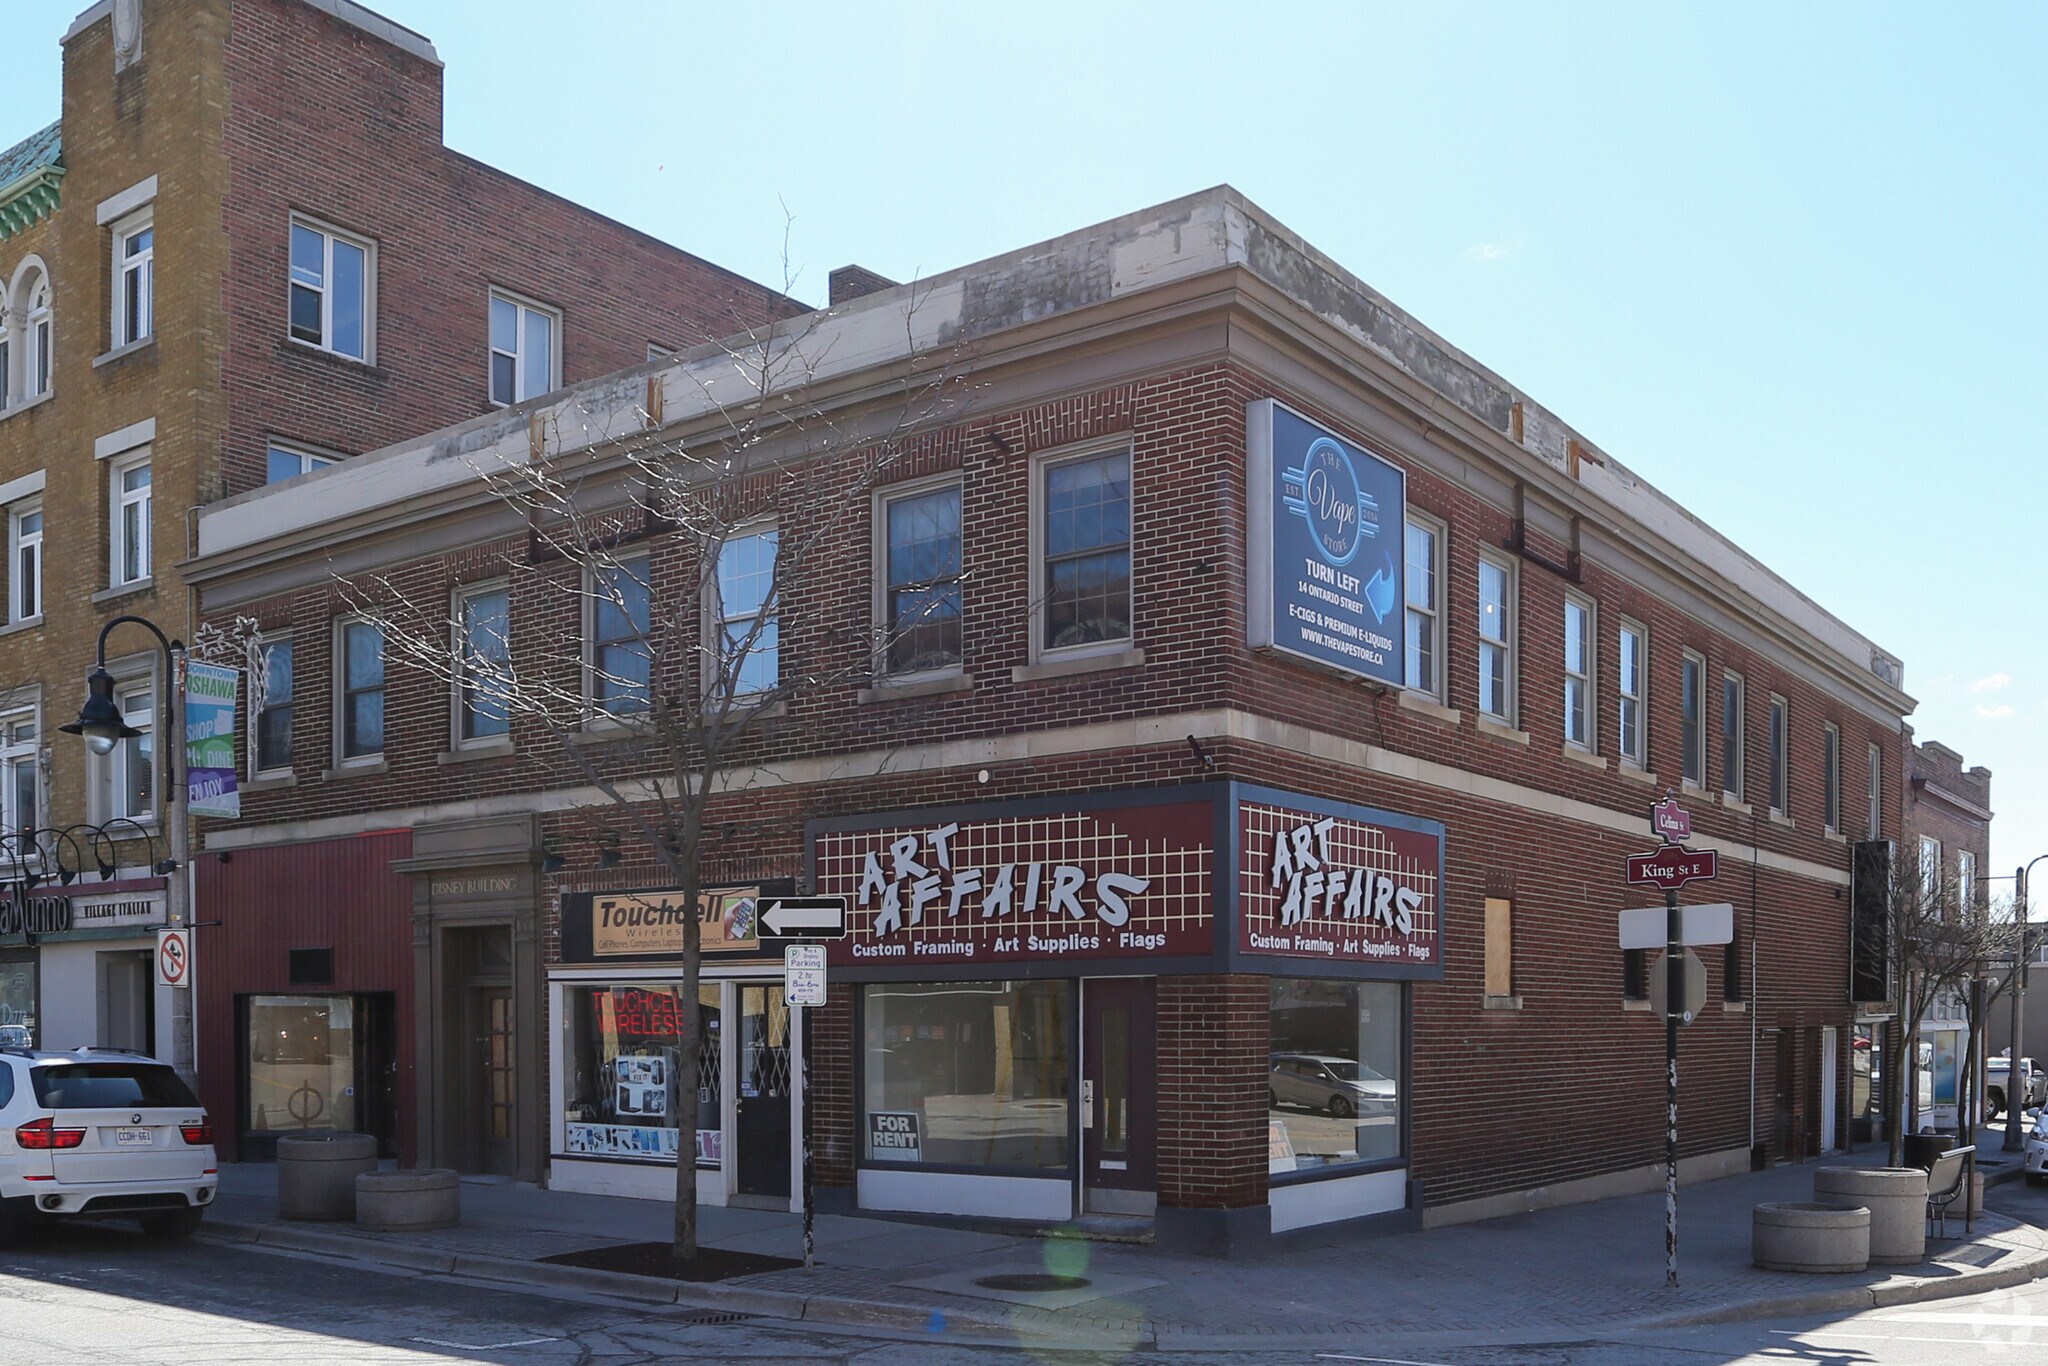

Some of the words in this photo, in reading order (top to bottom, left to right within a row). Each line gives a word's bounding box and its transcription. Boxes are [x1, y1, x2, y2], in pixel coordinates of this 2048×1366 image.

[1321, 453, 1342, 471] THE
[1308, 469, 1356, 534] Vape
[1363, 509, 1378, 522] 2014
[1323, 534, 1348, 552] STORE
[1305, 558, 1335, 586] TURN
[1337, 571, 1360, 595] LEFT
[1298, 580, 1308, 594] 14
[1308, 585, 1340, 606] ONTARIO
[1340, 596, 1364, 615] STREET
[1289, 603, 1316, 624] E-CIGS
[1316, 613, 1324, 627] &
[1324, 615, 1358, 639] PREMIUM
[1358, 627, 1393, 651] E-LIQUIDS
[1301, 626, 1384, 666] WWW.THEVAPESTORE.CA
[186, 664, 238, 679] DOWNTOWN
[186, 674, 236, 700] OSHAWA
[186, 720, 214, 743] SHOP
[207, 750, 234, 768] DINE
[189, 777, 223, 802] ENJOY
[858, 822, 959, 905] ART
[1272, 817, 1335, 888] ART
[1641, 864, 1674, 879] King
[1678, 865, 1689, 874] St
[1693, 864, 1700, 874] E
[432, 881, 465, 896] DISNEY
[468, 878, 516, 893] BUILDING
[84, 904, 116, 918] VILLAGE
[119, 901, 151, 915] ITALIAN
[873, 863, 1150, 938] AFFAIRS
[1281, 869, 1422, 935] AFFAIRS
[625, 928, 682, 937] Wireles
[663, 938, 684, 947] Laptop
[852, 943, 906, 957] Custom
[913, 940, 974, 956] Framing
[993, 937, 1019, 952] Art
[1028, 934, 1100, 953] Supplies
[1119, 932, 1166, 949] Flags
[1250, 932, 1290, 950] Custom
[1295, 935, 1334, 956] Framing
[1343, 941, 1358, 954] Art
[1362, 940, 1400, 958] Supplies
[1408, 943, 1430, 961] Flags
[790, 960, 821, 968] Parking
[592, 991, 683, 1013] TOUCHCEL
[877, 1116, 911, 1132] FOR
[873, 1131, 917, 1148] RENT
